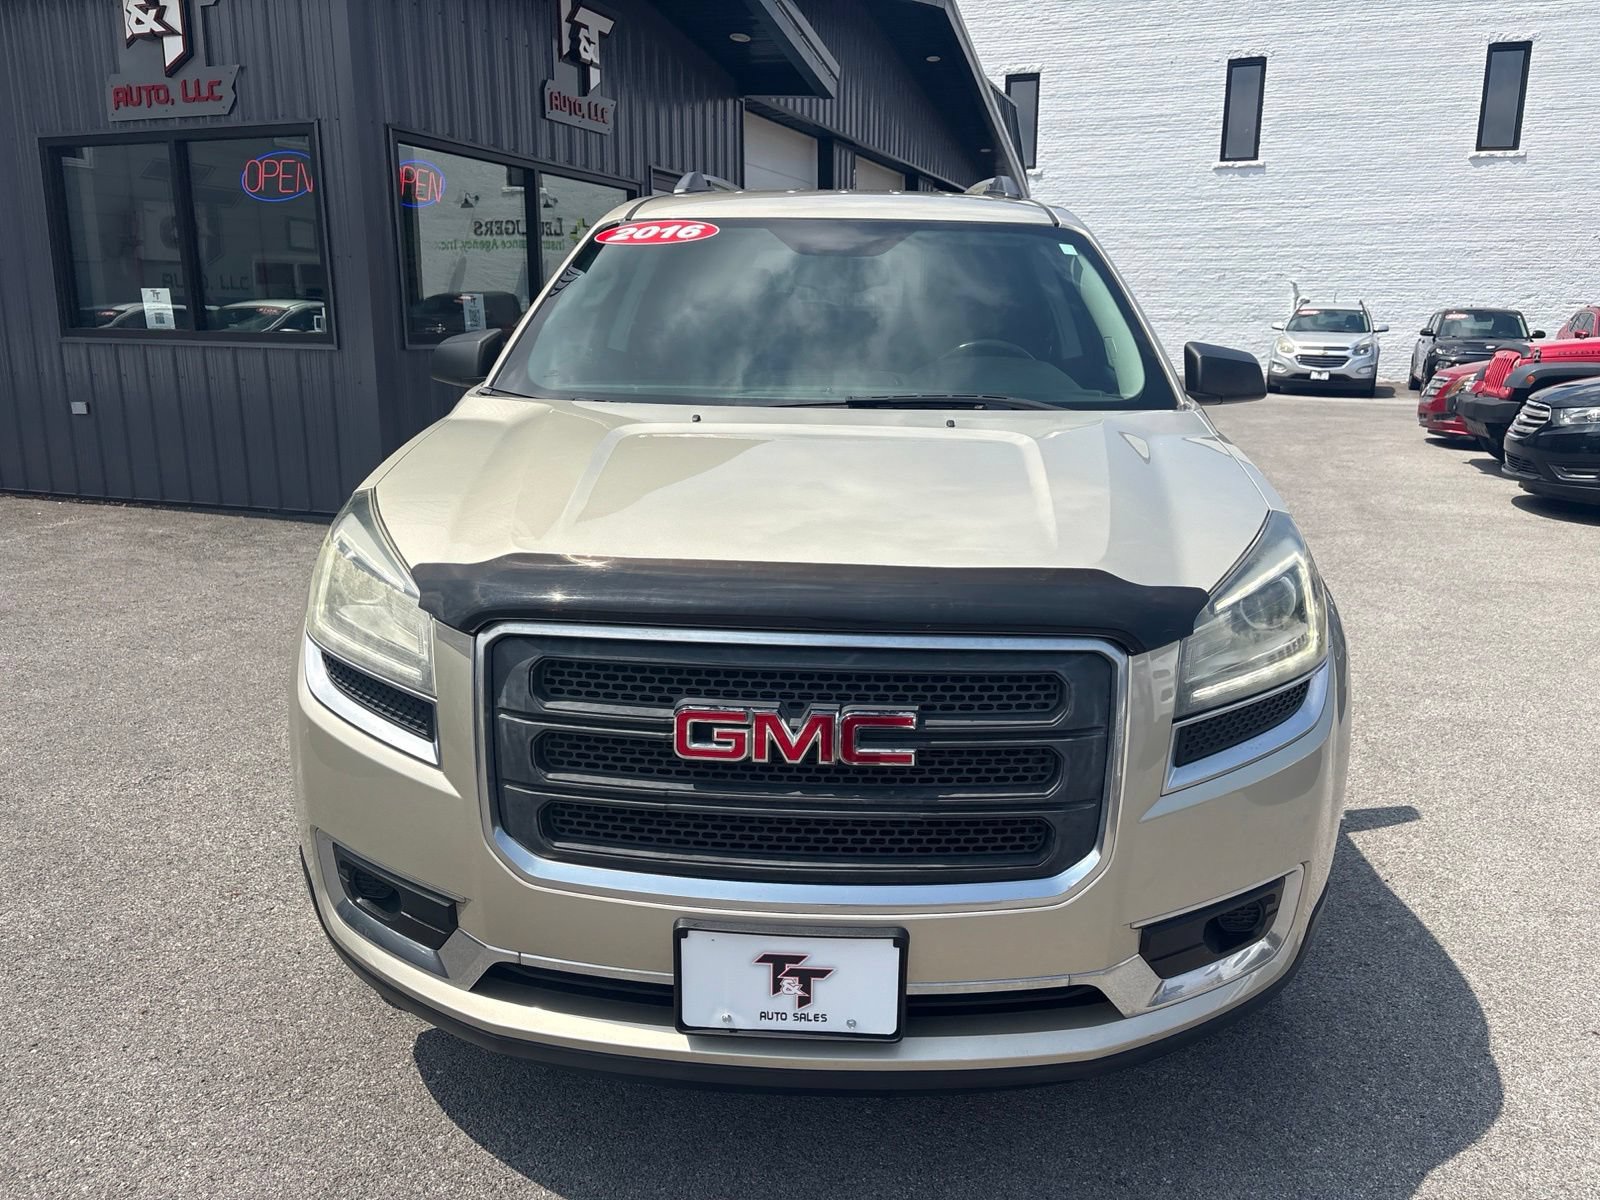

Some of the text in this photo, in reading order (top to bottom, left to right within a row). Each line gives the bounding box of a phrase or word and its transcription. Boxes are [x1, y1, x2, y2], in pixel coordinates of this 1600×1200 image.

[113, 79, 224, 111] AUTO, LLC
[549, 91, 609, 125] AUTO, LLC
[244, 159, 314, 193] OPEN
[400, 165, 443, 202] PEN
[605, 224, 706, 242] 2016
[673, 697, 918, 766] GMC
[752, 952, 837, 1010] T&T
[759, 1011, 828, 1023] AUTO SALES
